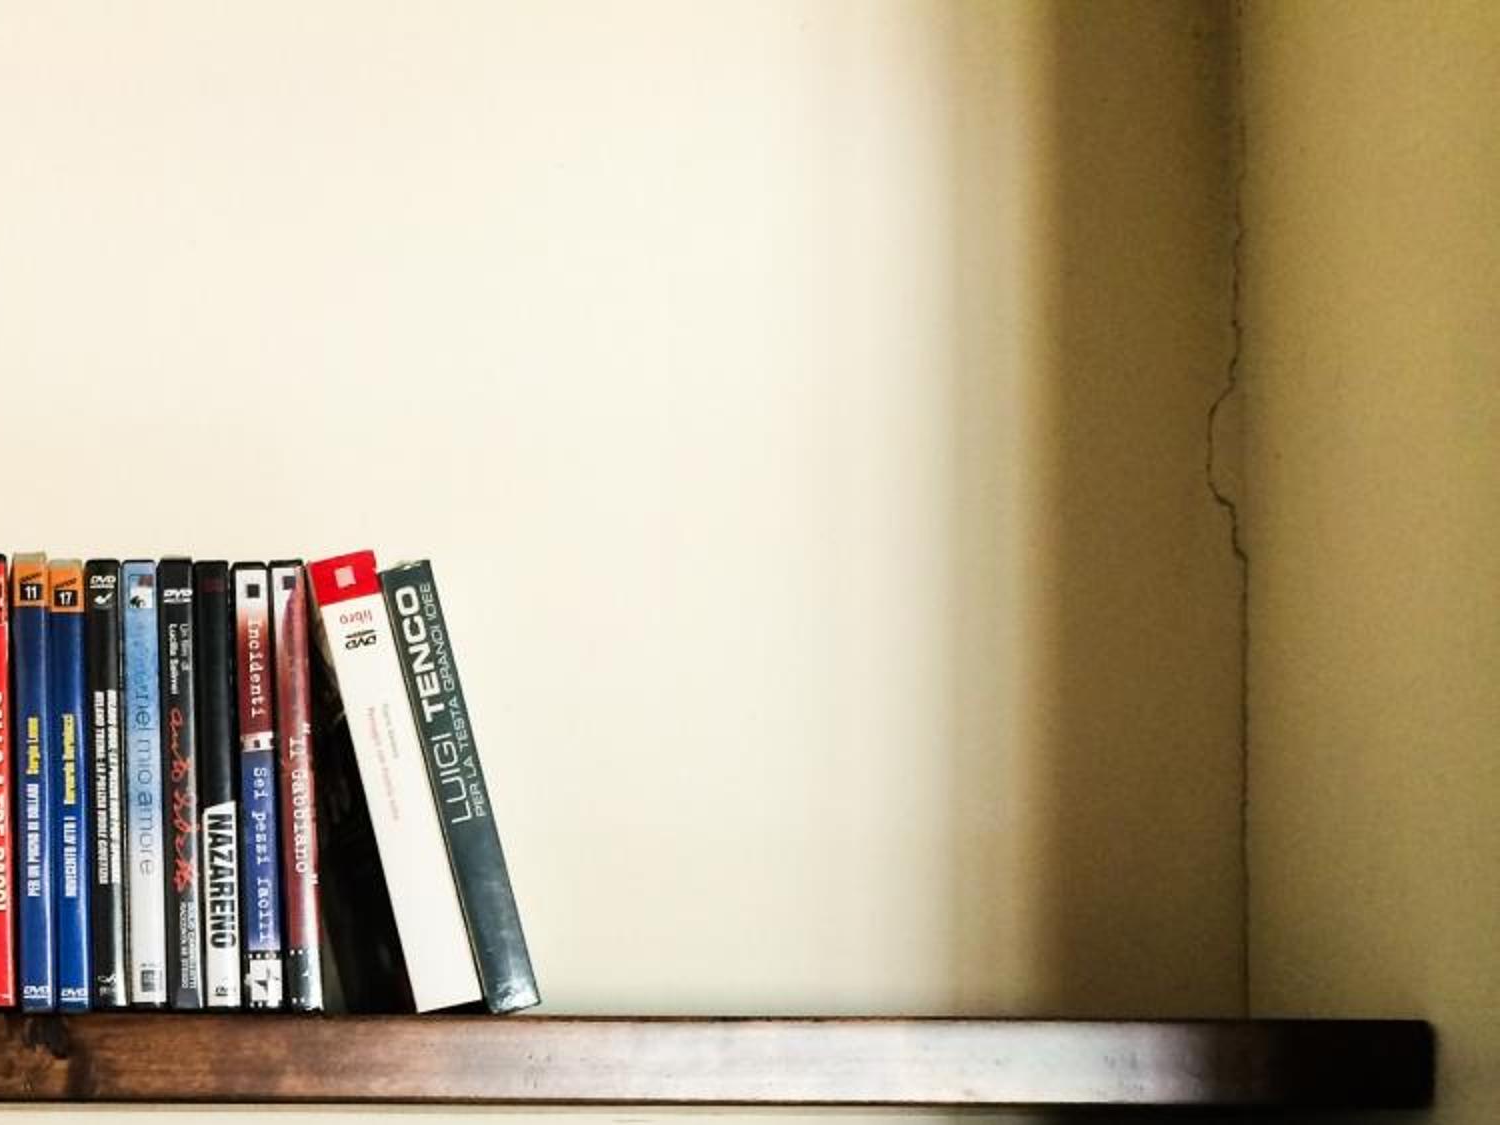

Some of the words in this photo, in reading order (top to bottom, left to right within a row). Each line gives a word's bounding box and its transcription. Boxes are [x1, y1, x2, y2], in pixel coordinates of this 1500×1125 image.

[24, 584, 38, 600] 11
[59, 590, 73, 606] 17
[421, 583, 436, 620] IDEE
[248, 617, 264, 717] Incidenti
[395, 586, 445, 722] TENCO
[432, 624, 454, 691] GRANDI
[450, 696, 469, 751] TESTA
[135, 739, 153, 784] mio
[253, 768, 269, 800] Sei
[431, 733, 472, 823] LUIGI
[464, 756, 476, 777] LA
[471, 783, 486, 817] PER
[137, 792, 156, 874] amore
[254, 812, 271, 865] pezzi
[207, 814, 235, 948] NAZARENO
[256, 877, 274, 943] facili
